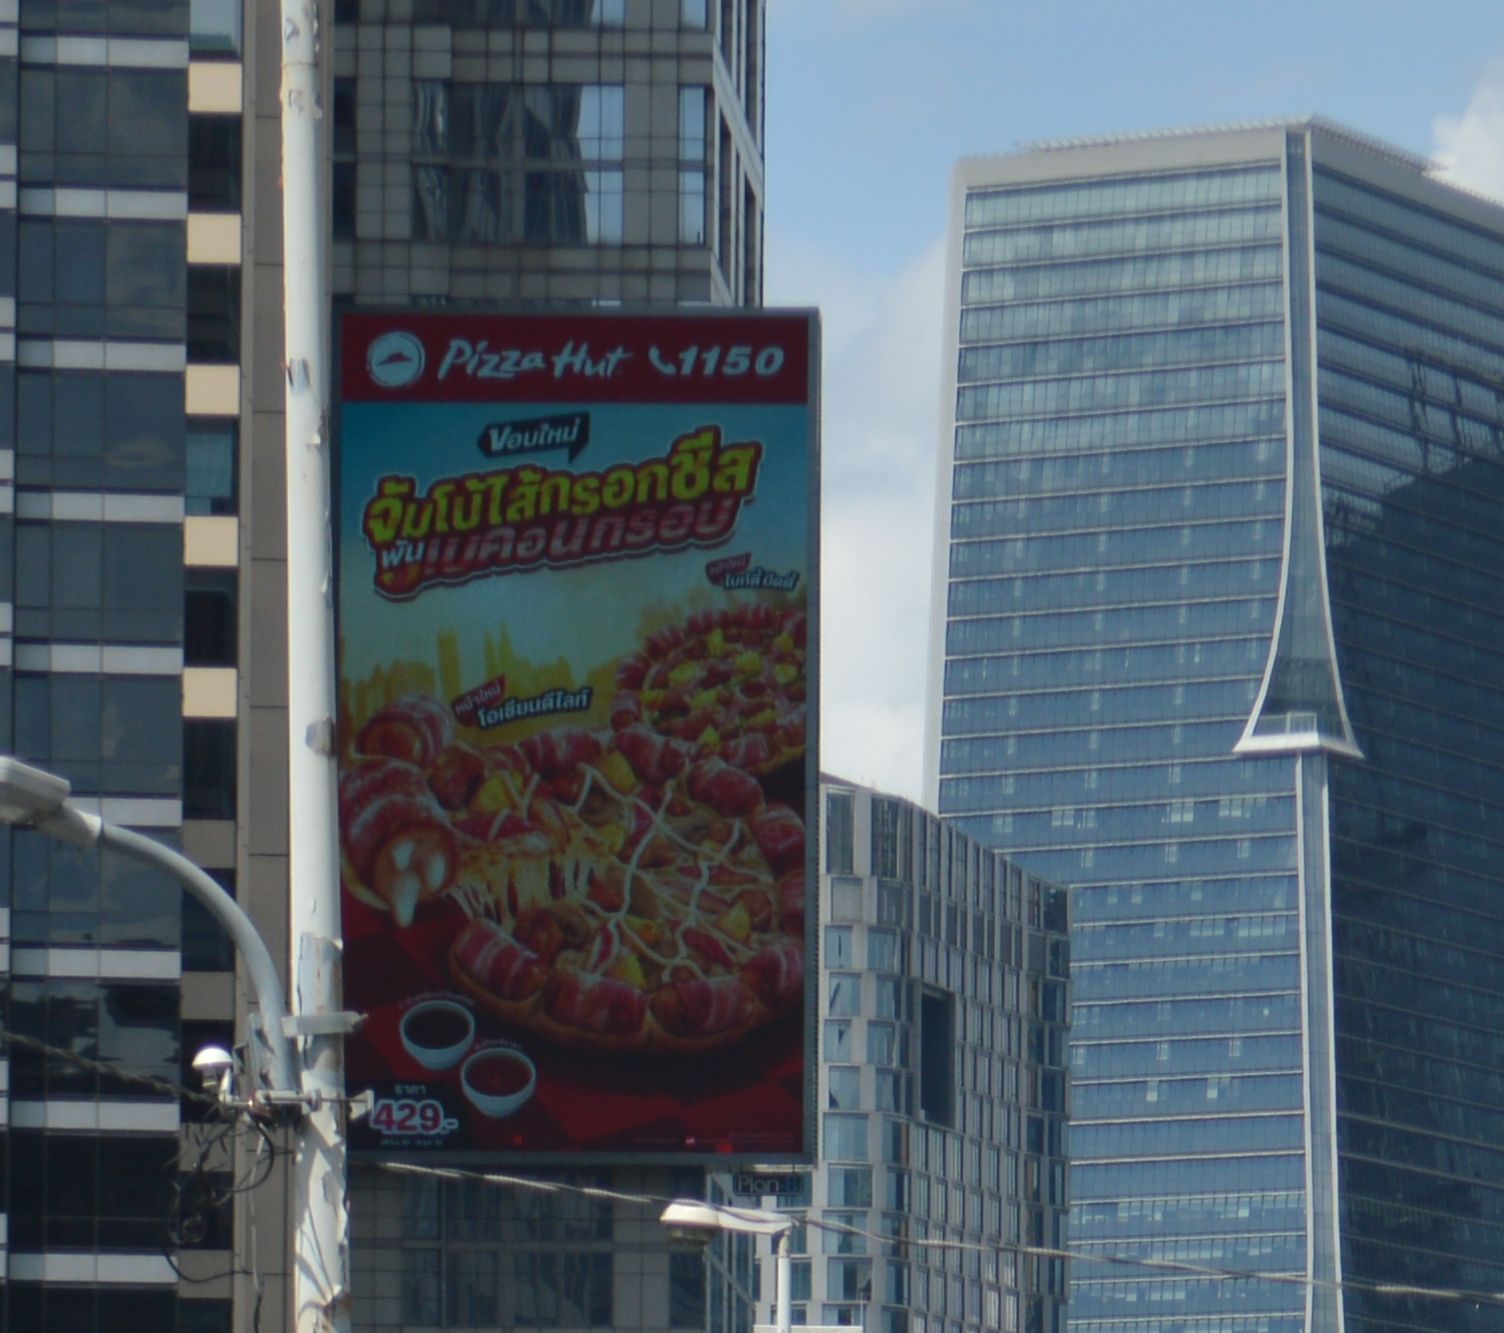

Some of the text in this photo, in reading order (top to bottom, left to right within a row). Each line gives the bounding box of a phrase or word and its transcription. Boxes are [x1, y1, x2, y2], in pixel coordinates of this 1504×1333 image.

[438, 339, 785, 380] Pizza Hut 1150
[487, 416, 579, 452] ขอบใหม่
